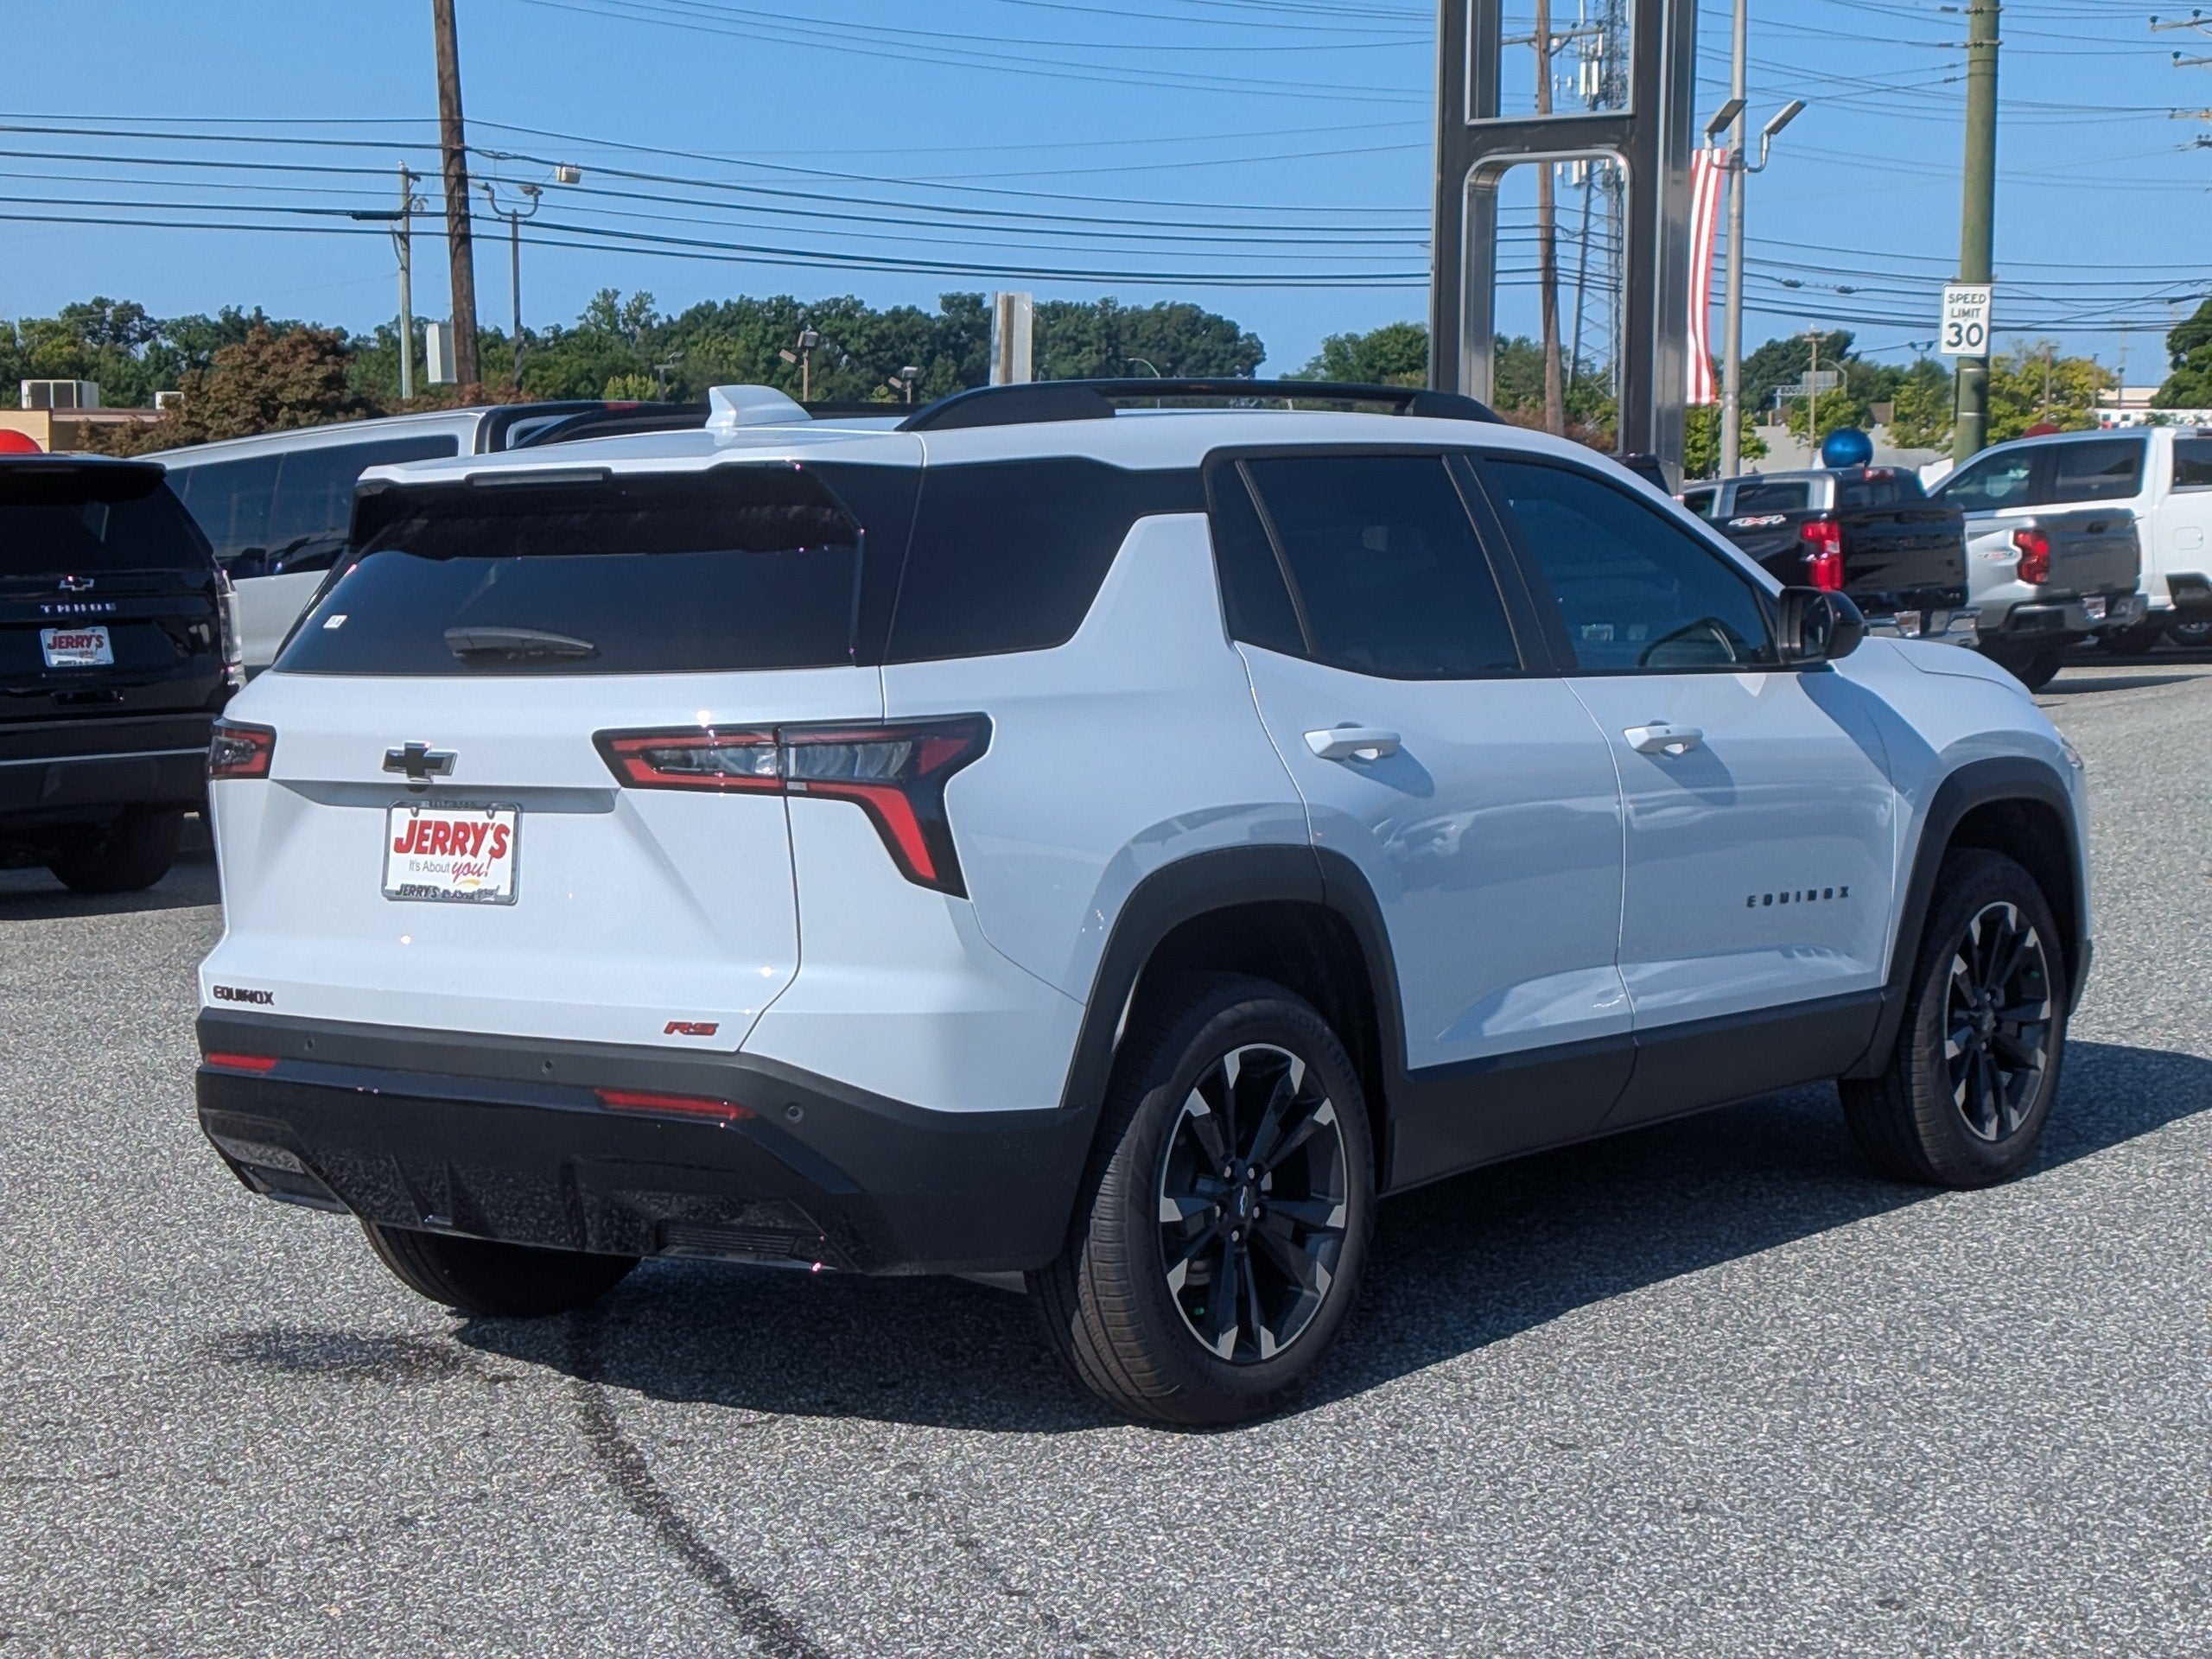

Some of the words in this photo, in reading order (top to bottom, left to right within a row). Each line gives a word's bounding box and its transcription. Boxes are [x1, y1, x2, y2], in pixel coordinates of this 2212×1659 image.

[1948, 293, 1986, 304] SPEED
[1950, 308, 1981, 318] LIMIT
[1945, 321, 1984, 347] 30
[47, 634, 105, 650] JERRY'S
[393, 819, 511, 860] JERRY'S
[409, 859, 421, 873] It's
[422, 861, 450, 874] About
[451, 856, 493, 883] you!
[394, 883, 441, 899] JERRY'S
[1746, 886, 1849, 907] EQUINOX
[213, 985, 276, 1006] EQUINOX
[663, 1021, 720, 1037] RS
